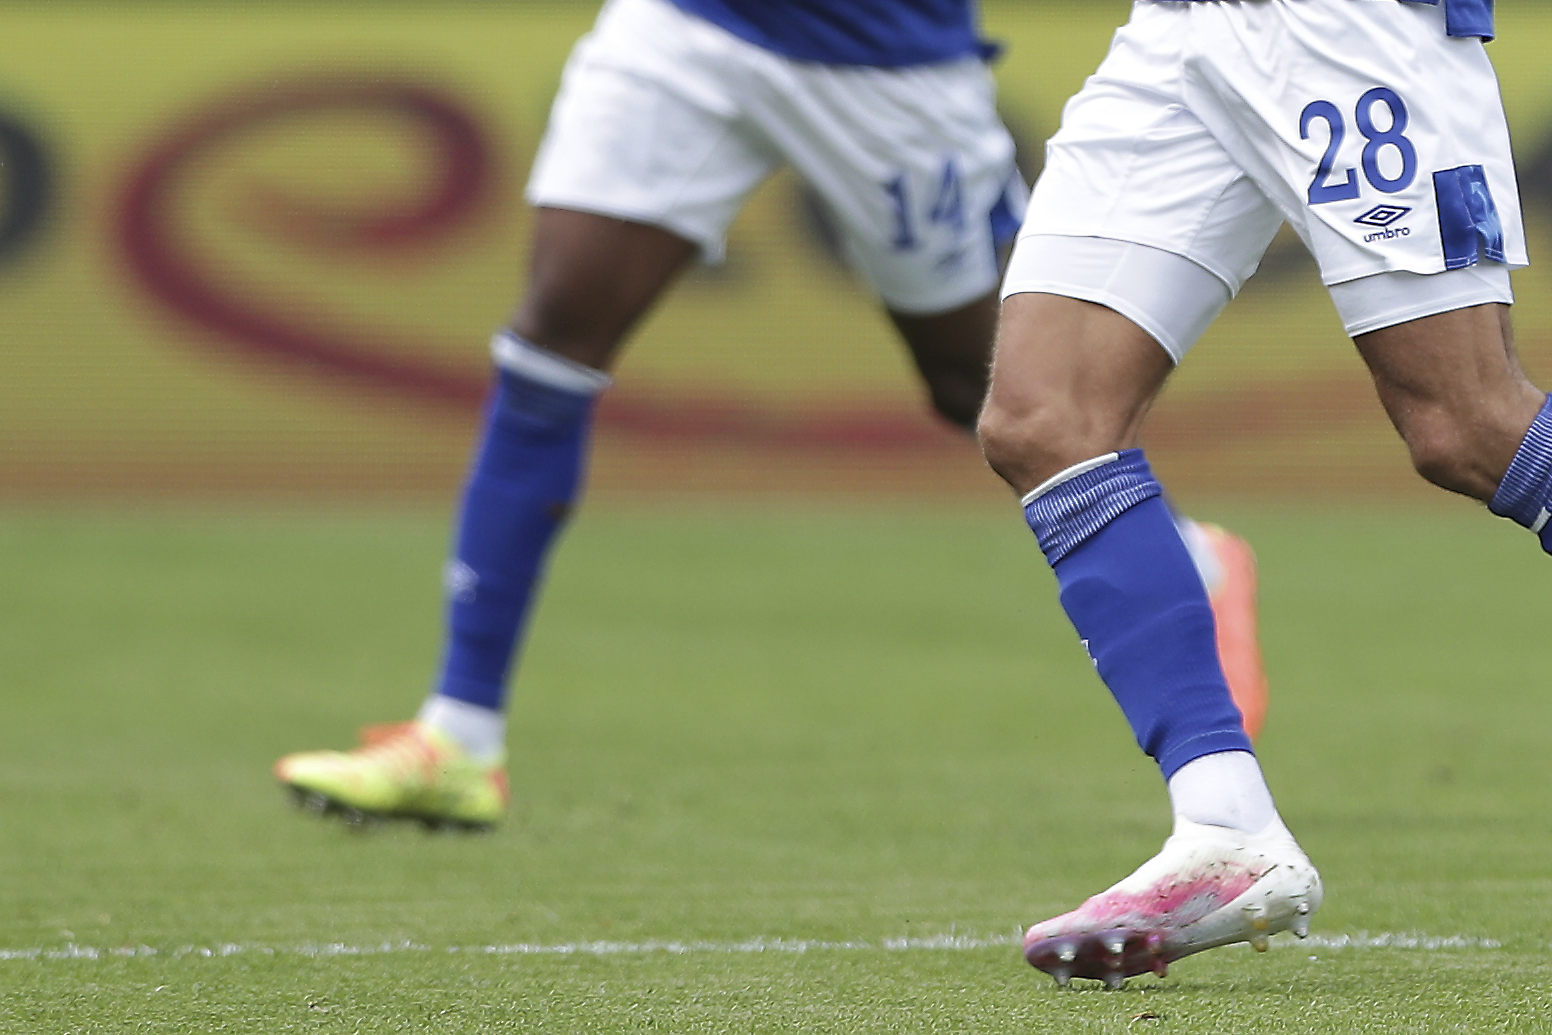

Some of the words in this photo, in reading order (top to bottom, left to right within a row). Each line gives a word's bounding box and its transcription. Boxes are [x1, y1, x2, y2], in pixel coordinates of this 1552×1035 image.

[1299, 86, 1417, 205] 28
[883, 158, 966, 251] 14
[1363, 226, 1411, 243] umbro
